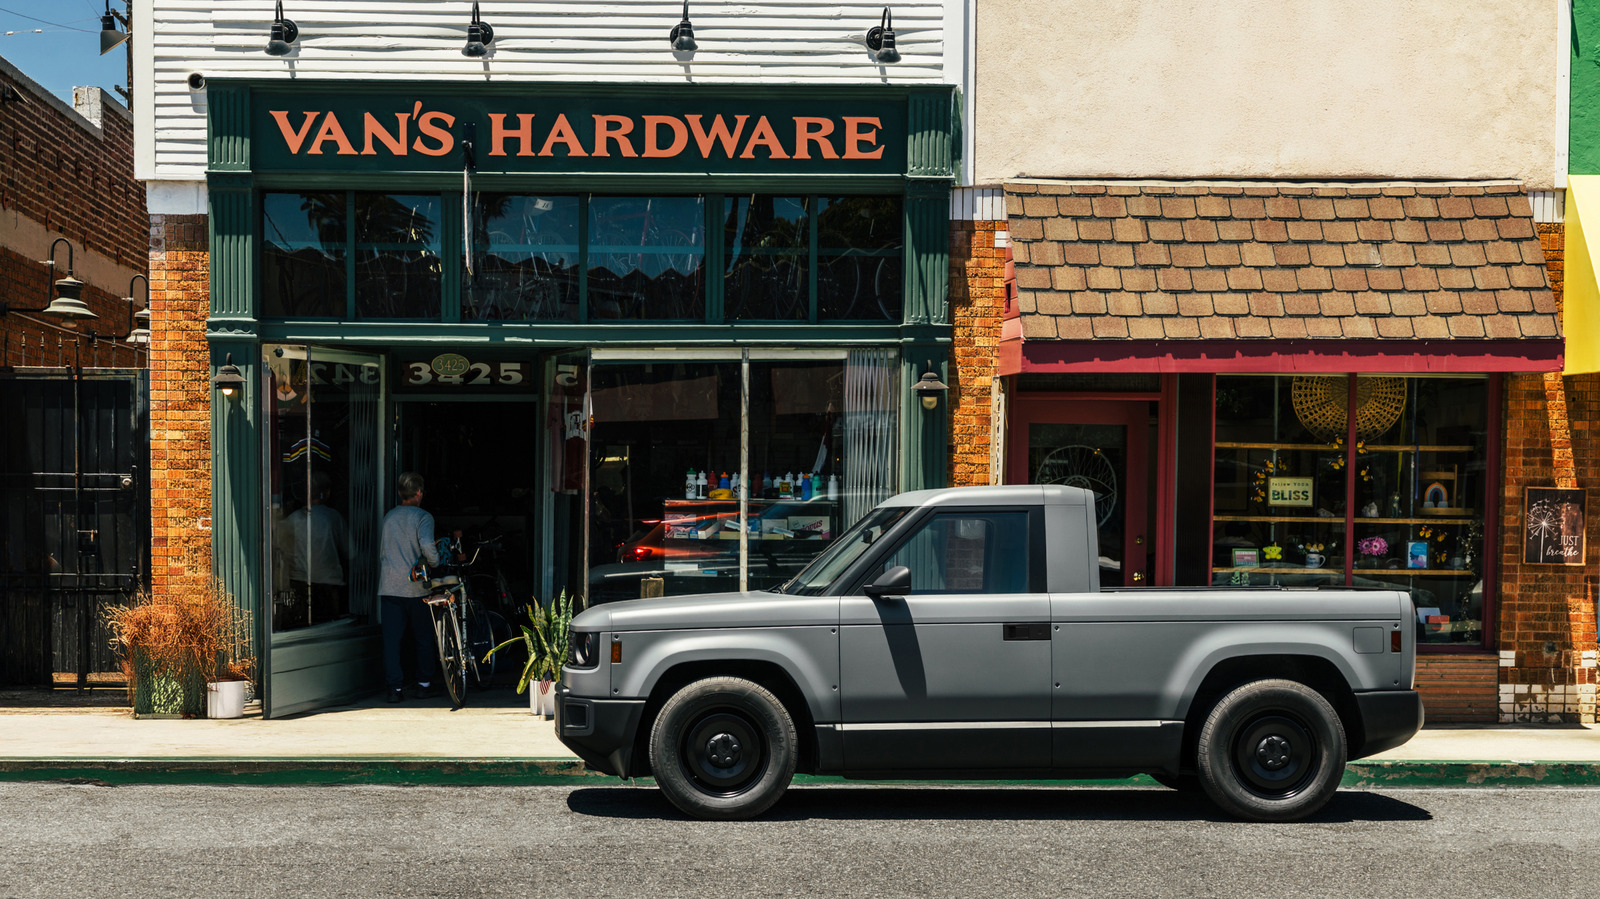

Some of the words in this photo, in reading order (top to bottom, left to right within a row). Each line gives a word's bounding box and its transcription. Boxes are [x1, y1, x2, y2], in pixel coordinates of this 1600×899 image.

[269, 101, 455, 156] VAN'S
[489, 113, 885, 160] HARDWARE
[438, 358, 465, 371] 3425
[1272, 490, 1309, 501] BLISS
[1559, 535, 1579, 545] JUST
[1546, 545, 1579, 557] breathe
